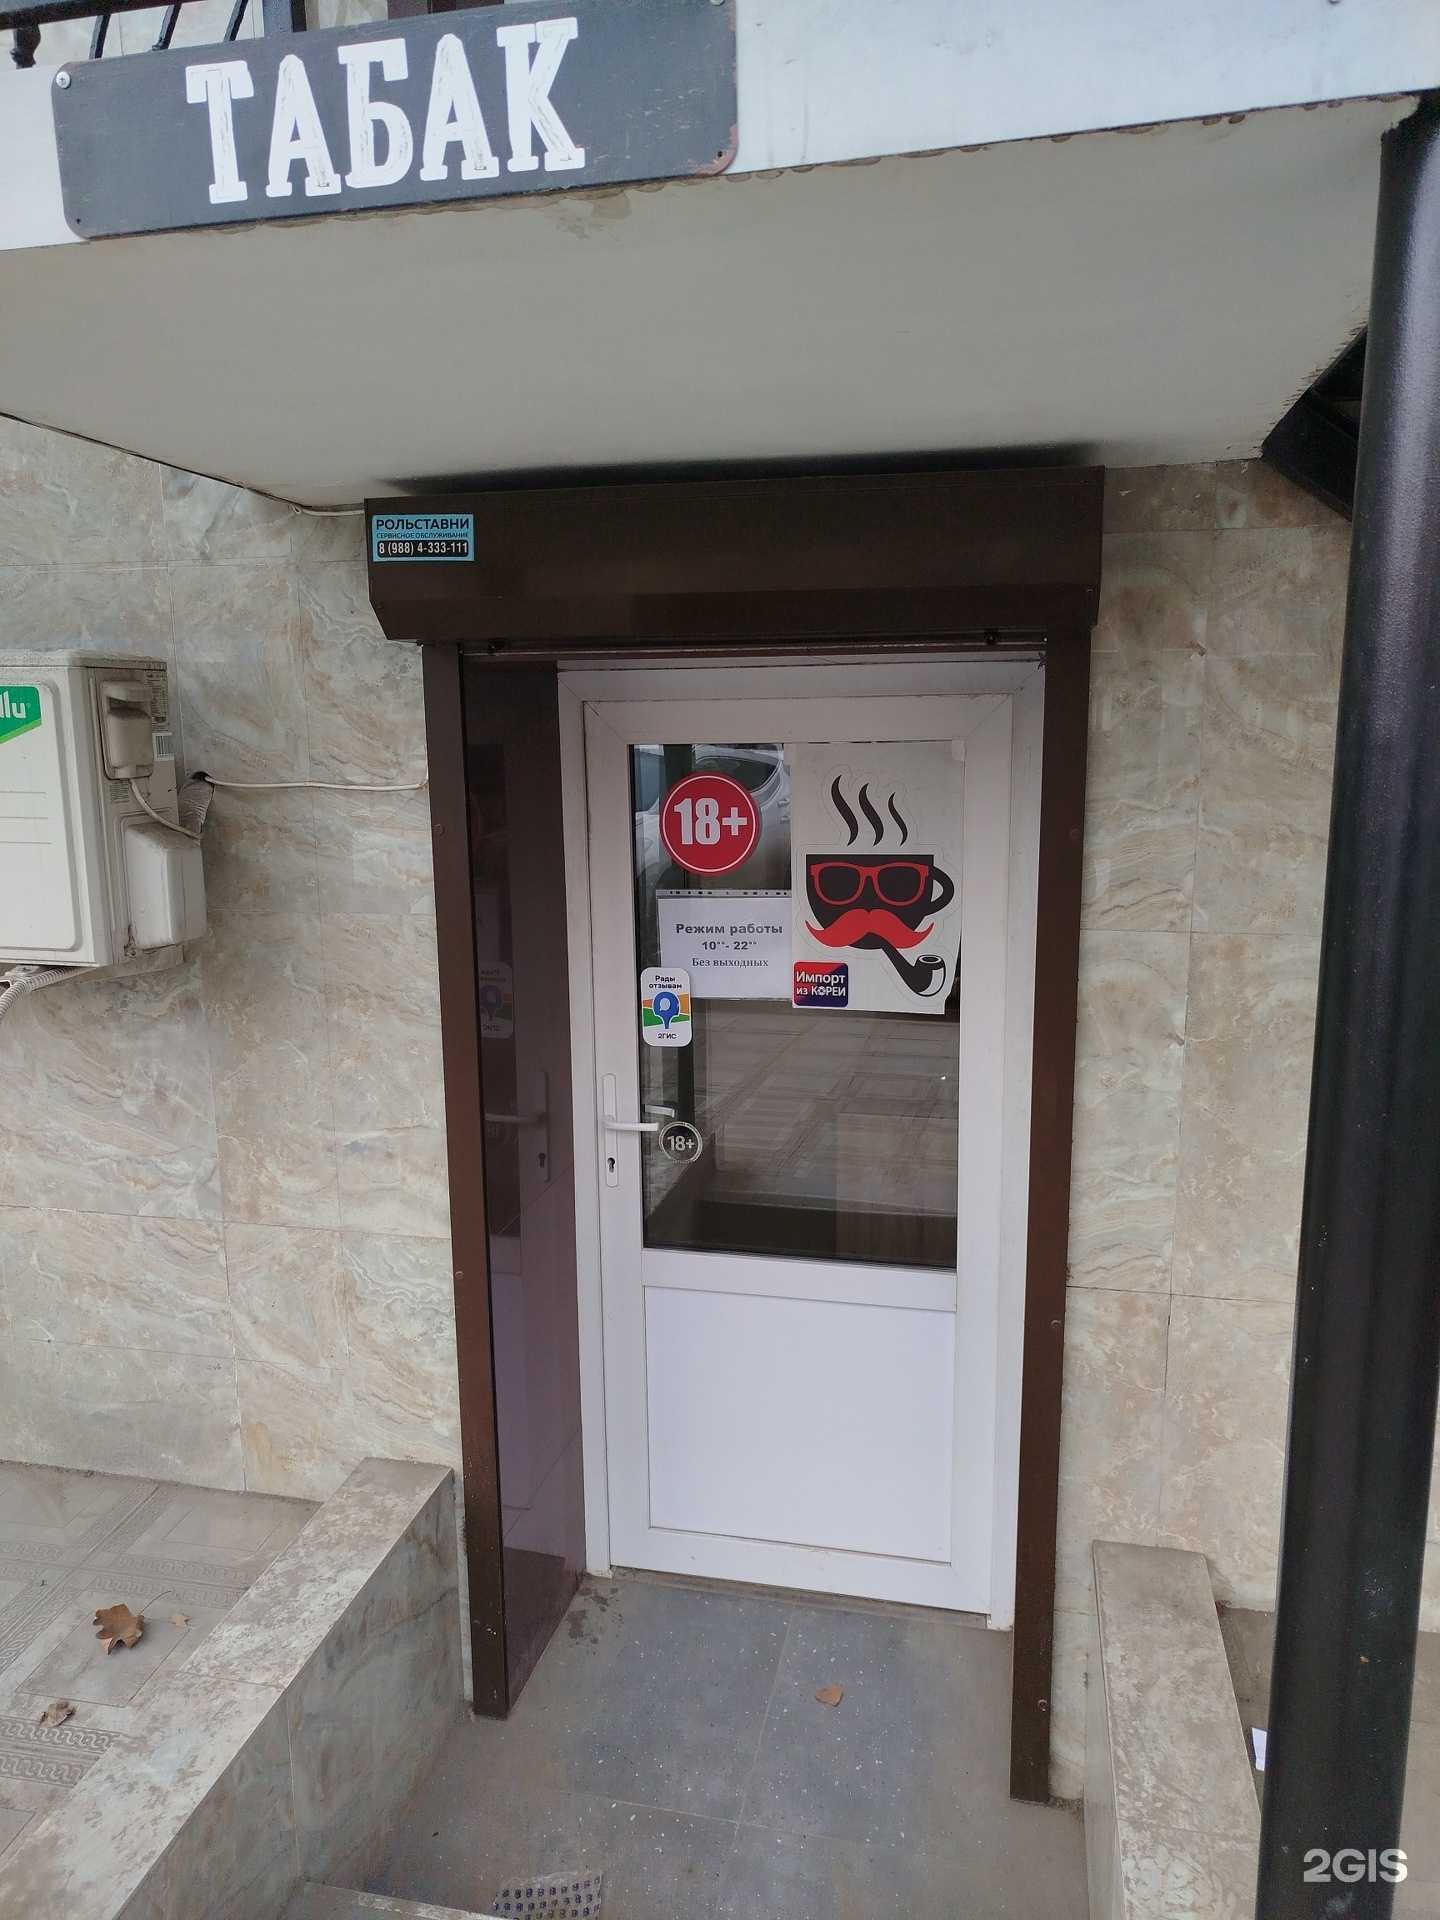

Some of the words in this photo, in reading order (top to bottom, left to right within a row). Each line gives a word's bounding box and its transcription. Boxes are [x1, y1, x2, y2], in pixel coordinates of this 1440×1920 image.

[186, 17, 585, 204] ТАБАК
[376, 518, 469, 530] РОЛЬСТАВНИ
[379, 542, 385, 554] 8
[388, 541, 414, 556] (988)
[417, 541, 468, 554] 4-333-111
[673, 797, 748, 846] 18+
[675, 923, 725, 934] Режим
[730, 923, 783, 936] работы
[692, 958, 711, 967] Без
[713, 959, 769, 968] выходных
[655, 975, 676, 983] Рады
[796, 970, 846, 986] Импорт
[796, 987, 808, 995] из
[657, 1032, 677, 1040] 2ГИС
[667, 1135, 695, 1151] 18+
